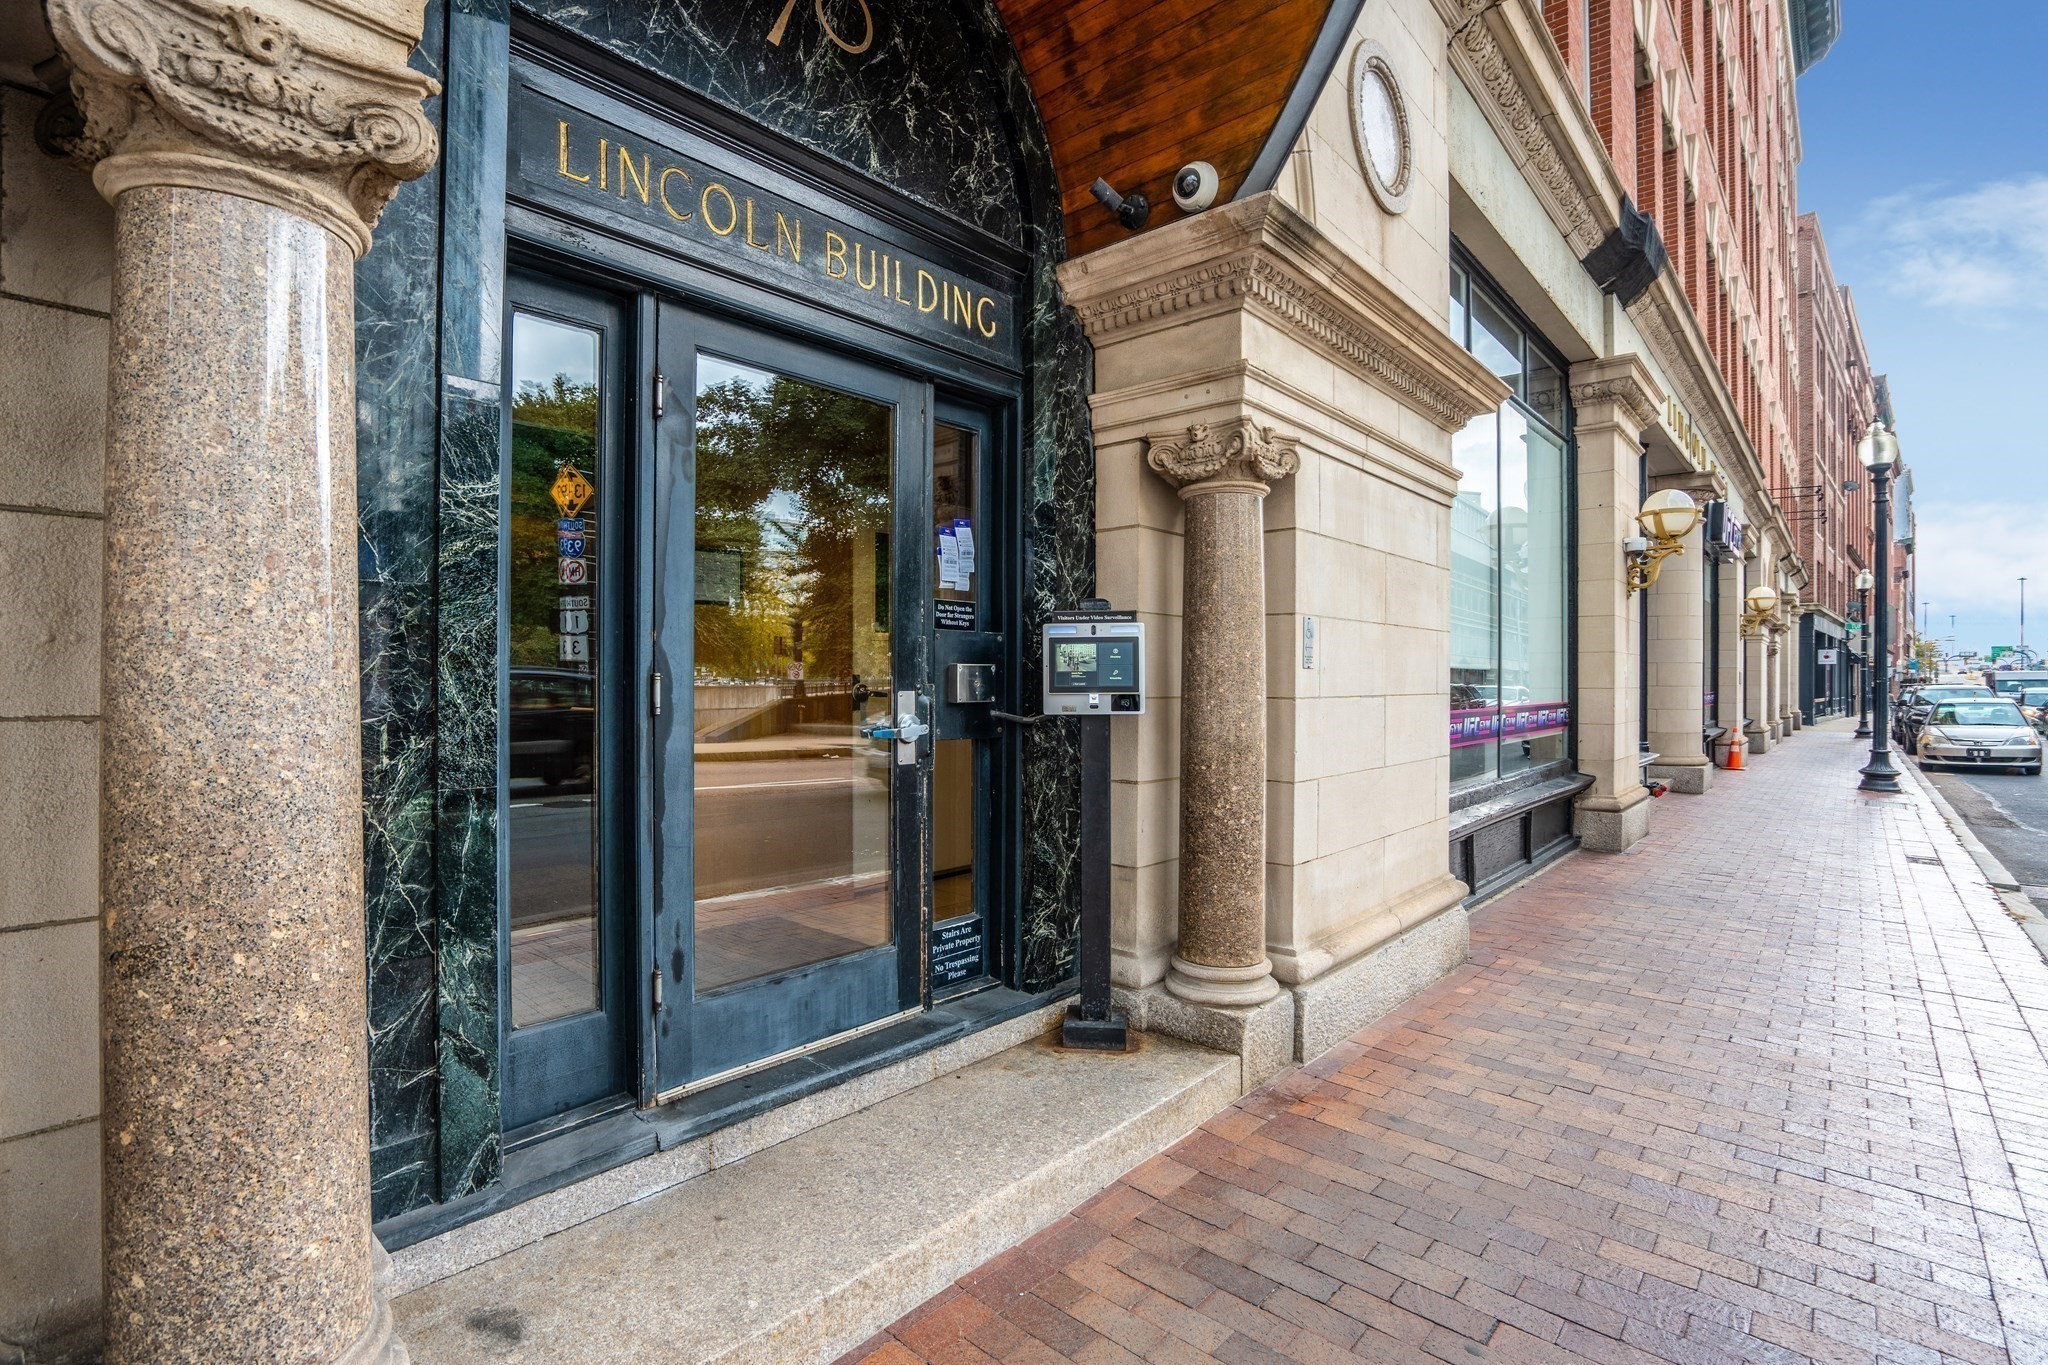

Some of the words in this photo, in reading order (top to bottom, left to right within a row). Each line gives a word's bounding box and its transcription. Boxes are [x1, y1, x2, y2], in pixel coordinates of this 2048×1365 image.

[557, 120, 802, 264] LINCOLN
[825, 230, 997, 338] BUILDING
[1464, 717, 1480, 737] UFC
[1516, 712, 1529, 729] UFC
[1538, 710, 1549, 726] UFC
[942, 929, 960, 940] Stairs
[961, 926, 972, 934] Are
[932, 942, 954, 954] Private
[955, 934, 981, 947] Property
[934, 964, 944, 974] No
[945, 954, 979, 970] Trespassing
[947, 969, 966, 980] Please
